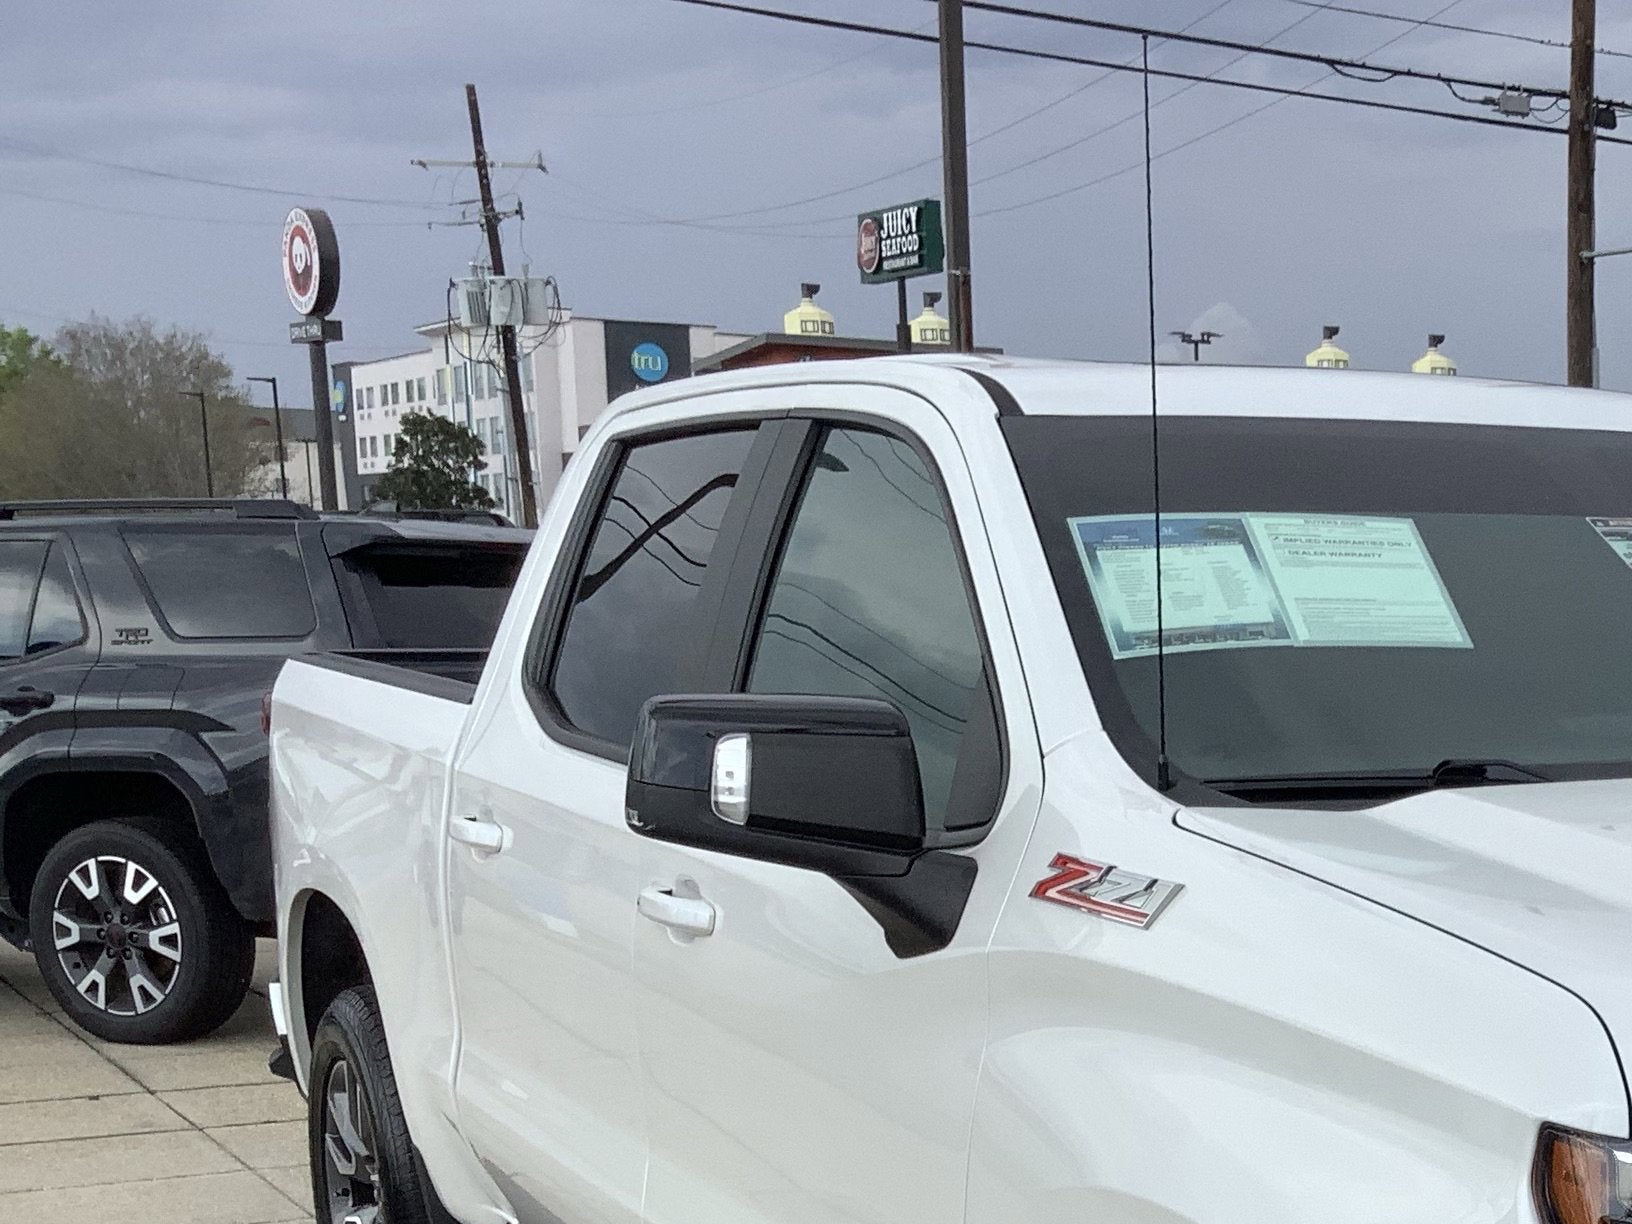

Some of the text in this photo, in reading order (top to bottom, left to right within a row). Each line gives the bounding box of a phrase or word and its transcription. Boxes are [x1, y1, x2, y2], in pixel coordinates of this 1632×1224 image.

[880, 206, 918, 239] JUICY
[881, 233, 920, 258] SEAFOOD
[631, 352, 662, 371] tru
[1329, 551, 1383, 559] WARRANTY
[1028, 852, 1186, 931] Z71
